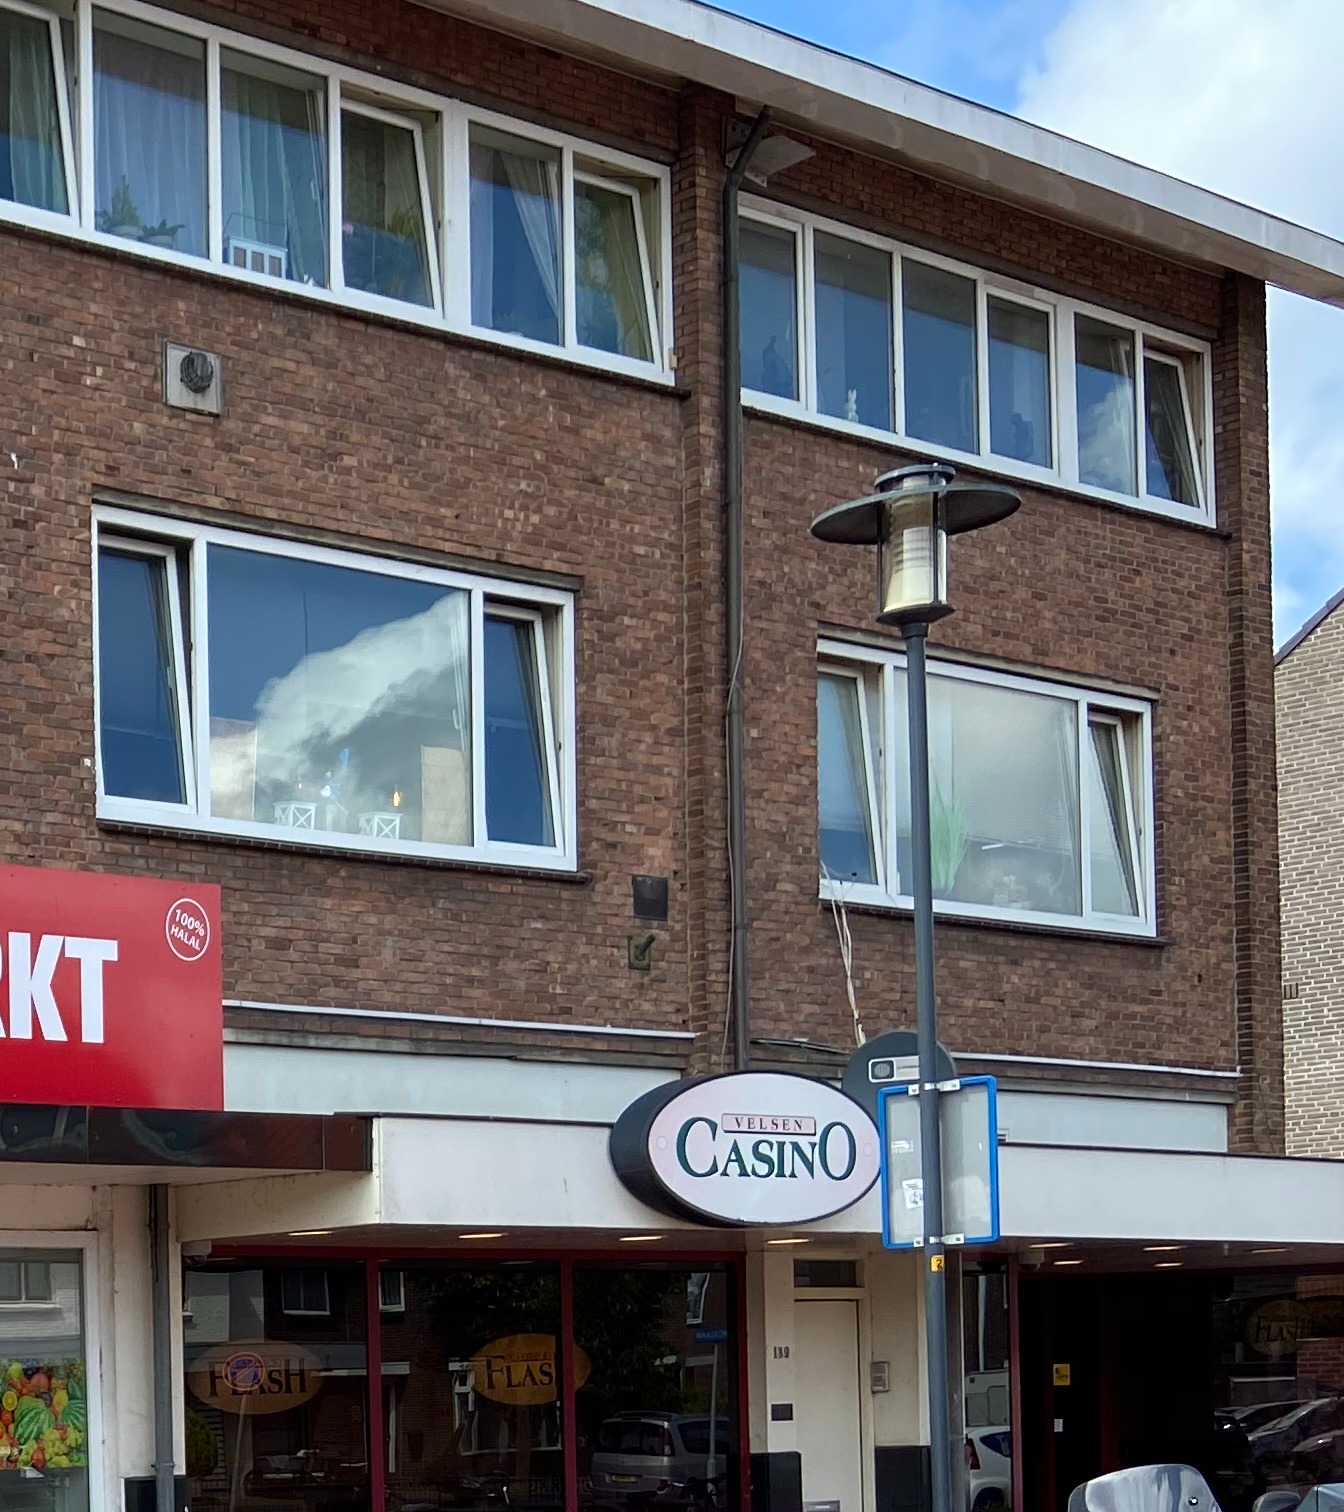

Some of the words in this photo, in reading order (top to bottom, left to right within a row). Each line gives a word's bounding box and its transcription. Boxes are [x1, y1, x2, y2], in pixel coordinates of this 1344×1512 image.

[170, 923, 201, 951] HALAL
[175, 908, 205, 937] 100%
[734, 1117, 804, 1131] VELSEN
[676, 1116, 857, 1181] CASINO
[485, 1354, 556, 1390] FLAS
